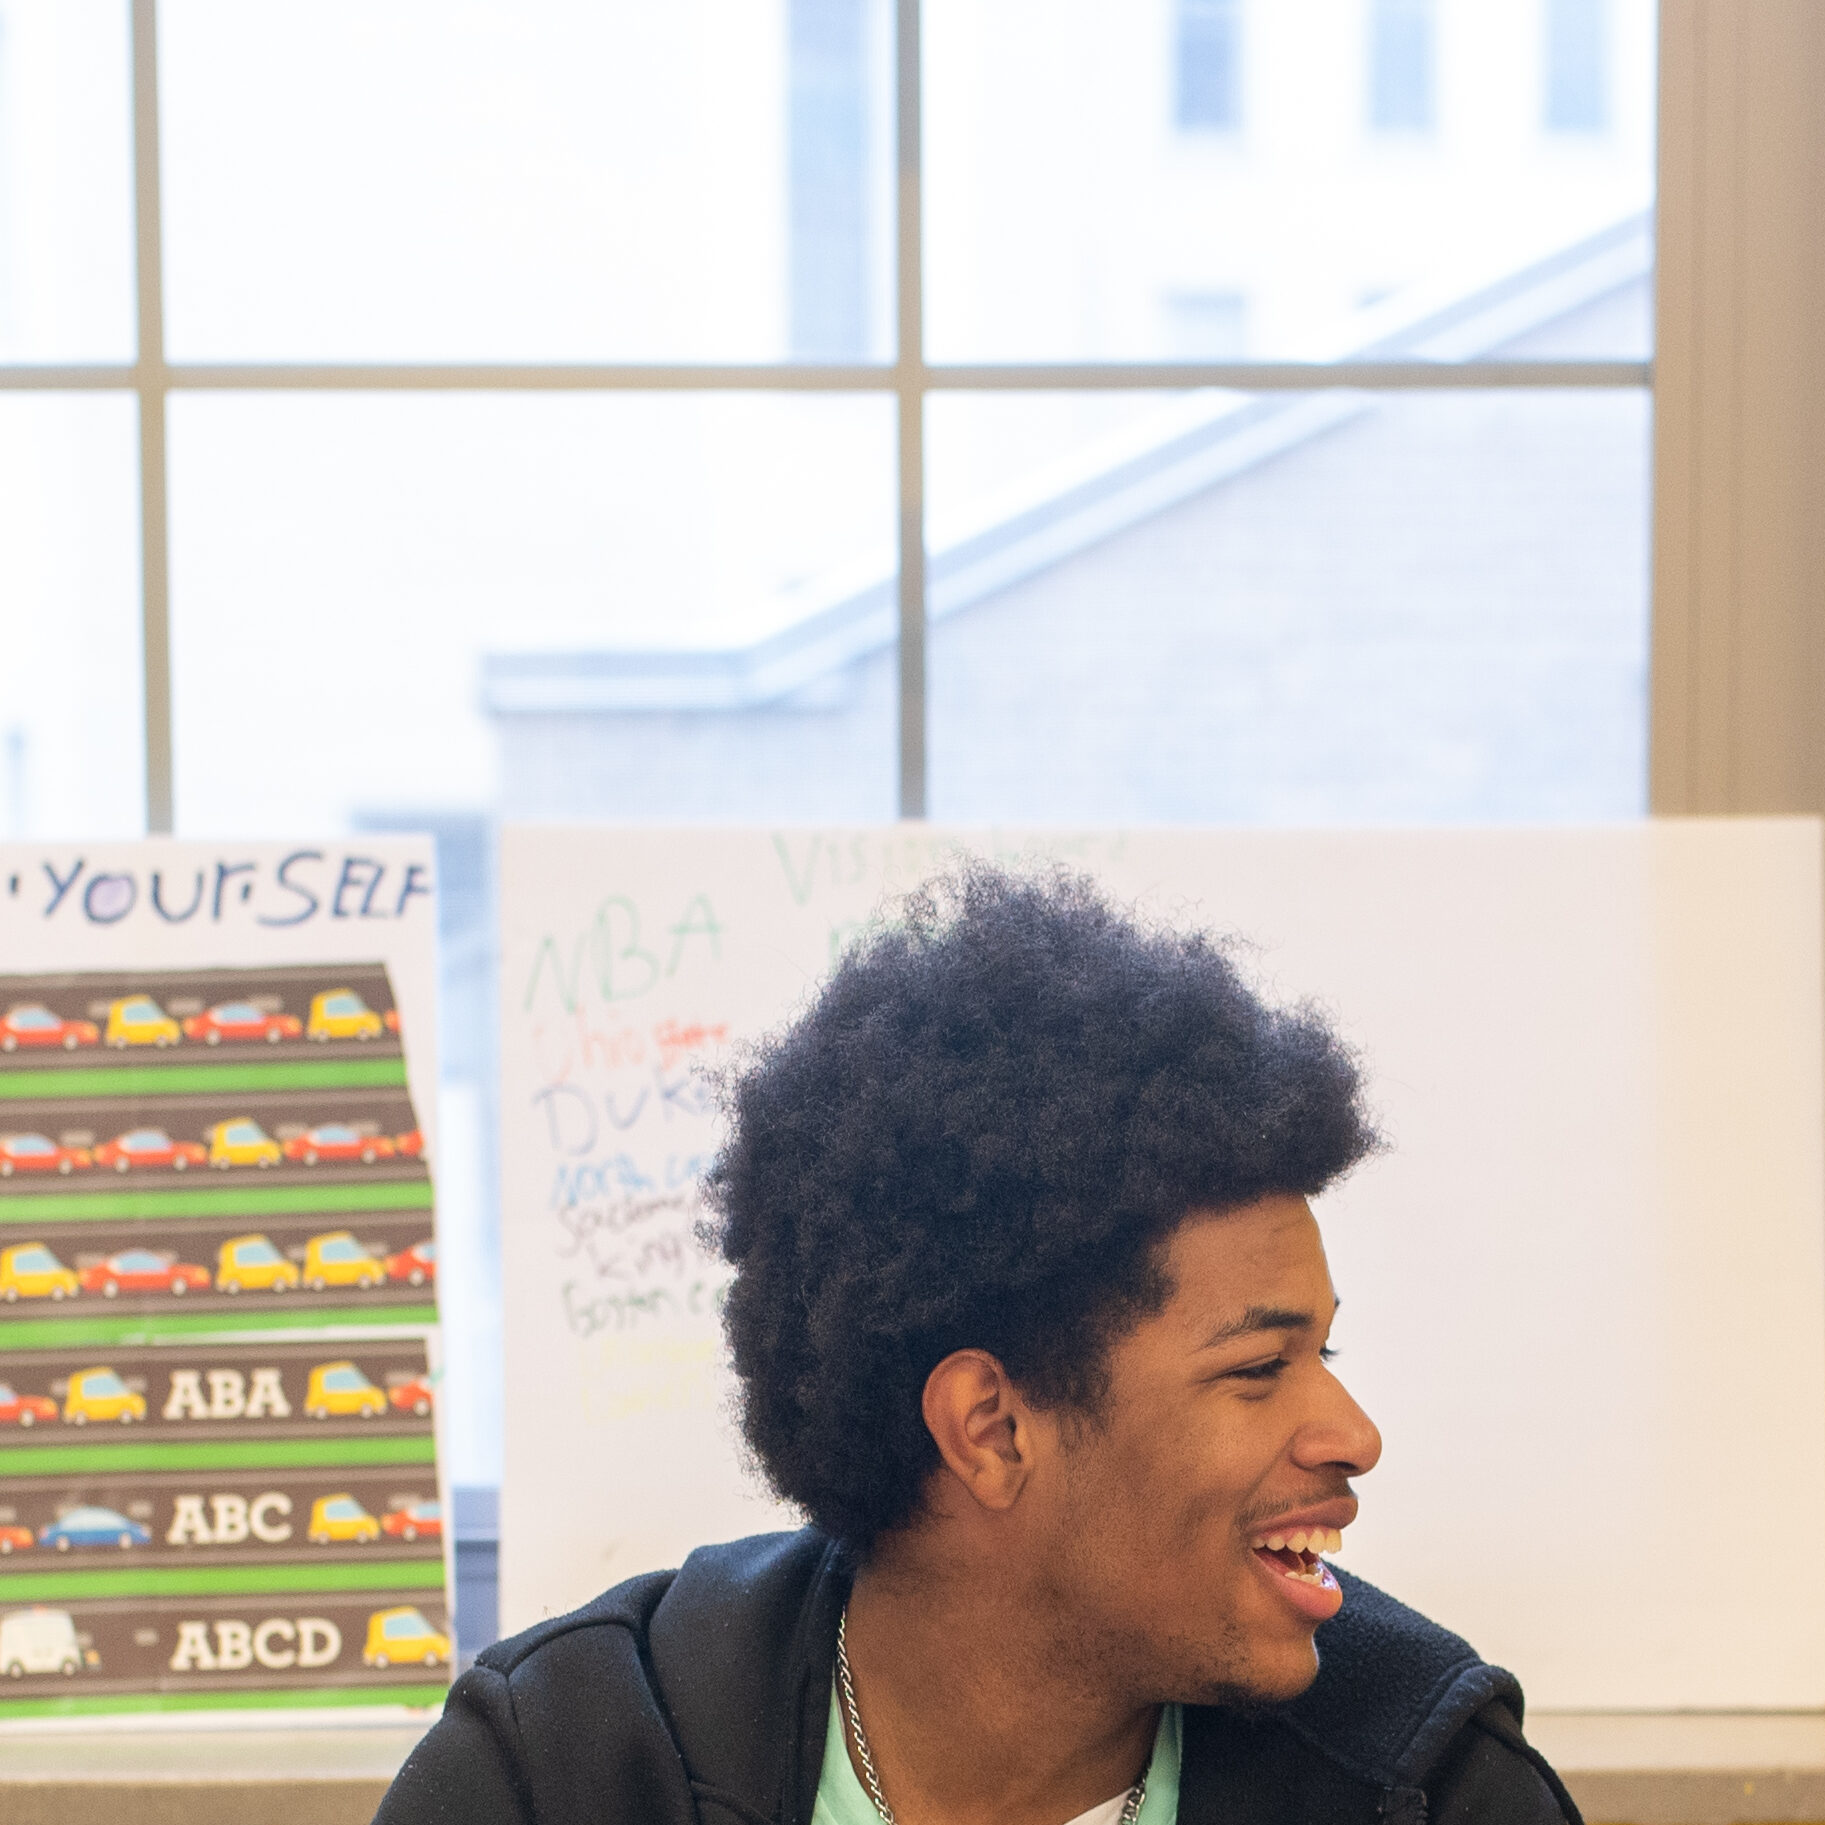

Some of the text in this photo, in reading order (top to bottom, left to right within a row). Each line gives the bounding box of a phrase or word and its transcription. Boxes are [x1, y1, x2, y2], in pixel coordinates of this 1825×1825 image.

[523, 893, 727, 1015] NBA
[162, 1366, 292, 1421] ABA
[167, 1491, 292, 1545] ABC
[170, 1616, 342, 1672] ABCD
